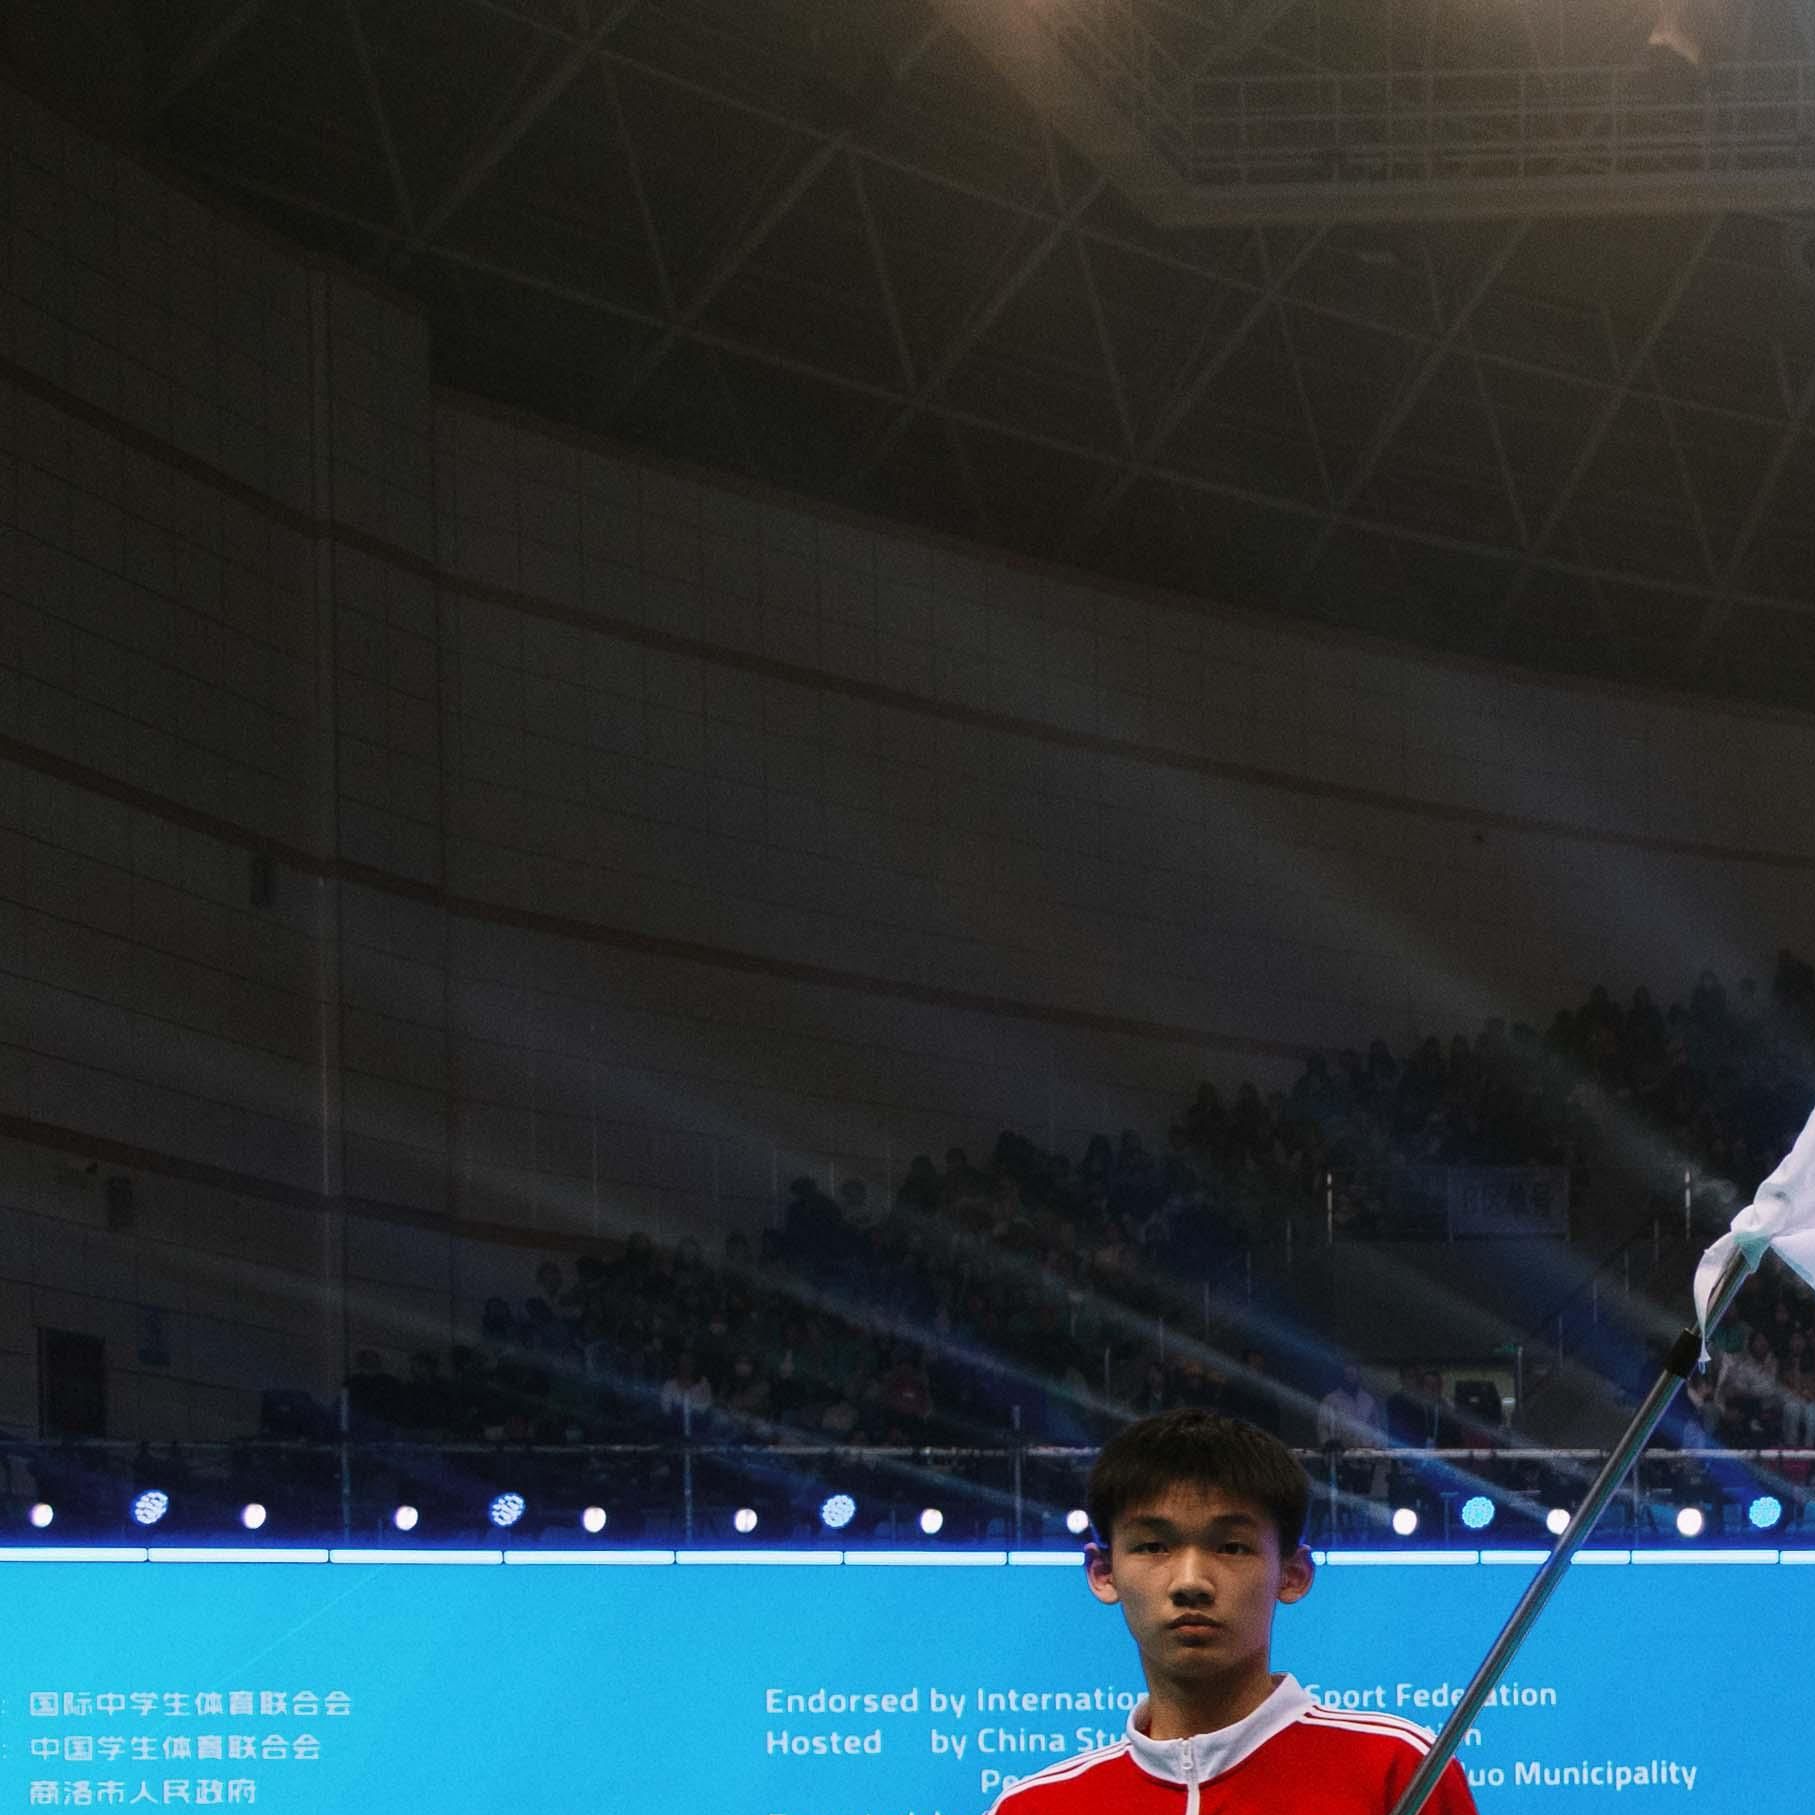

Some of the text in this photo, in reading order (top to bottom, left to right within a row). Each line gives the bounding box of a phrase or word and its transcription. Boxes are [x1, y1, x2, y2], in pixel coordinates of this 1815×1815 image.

[30, 1690, 352, 1717] 国际中学生体育联合会
[765, 1688, 919, 1714] Endorsed
[929, 1687, 967, 1718] by
[30, 1733, 321, 1761] 中国学生体育联合会
[766, 1729, 883, 1755] Hosted
[930, 1729, 968, 1760] by
[977, 1727, 1066, 1753] China
[1514, 1760, 1698, 1791] Municipality
[29, 1778, 257, 1806] 商洛市人民政府
